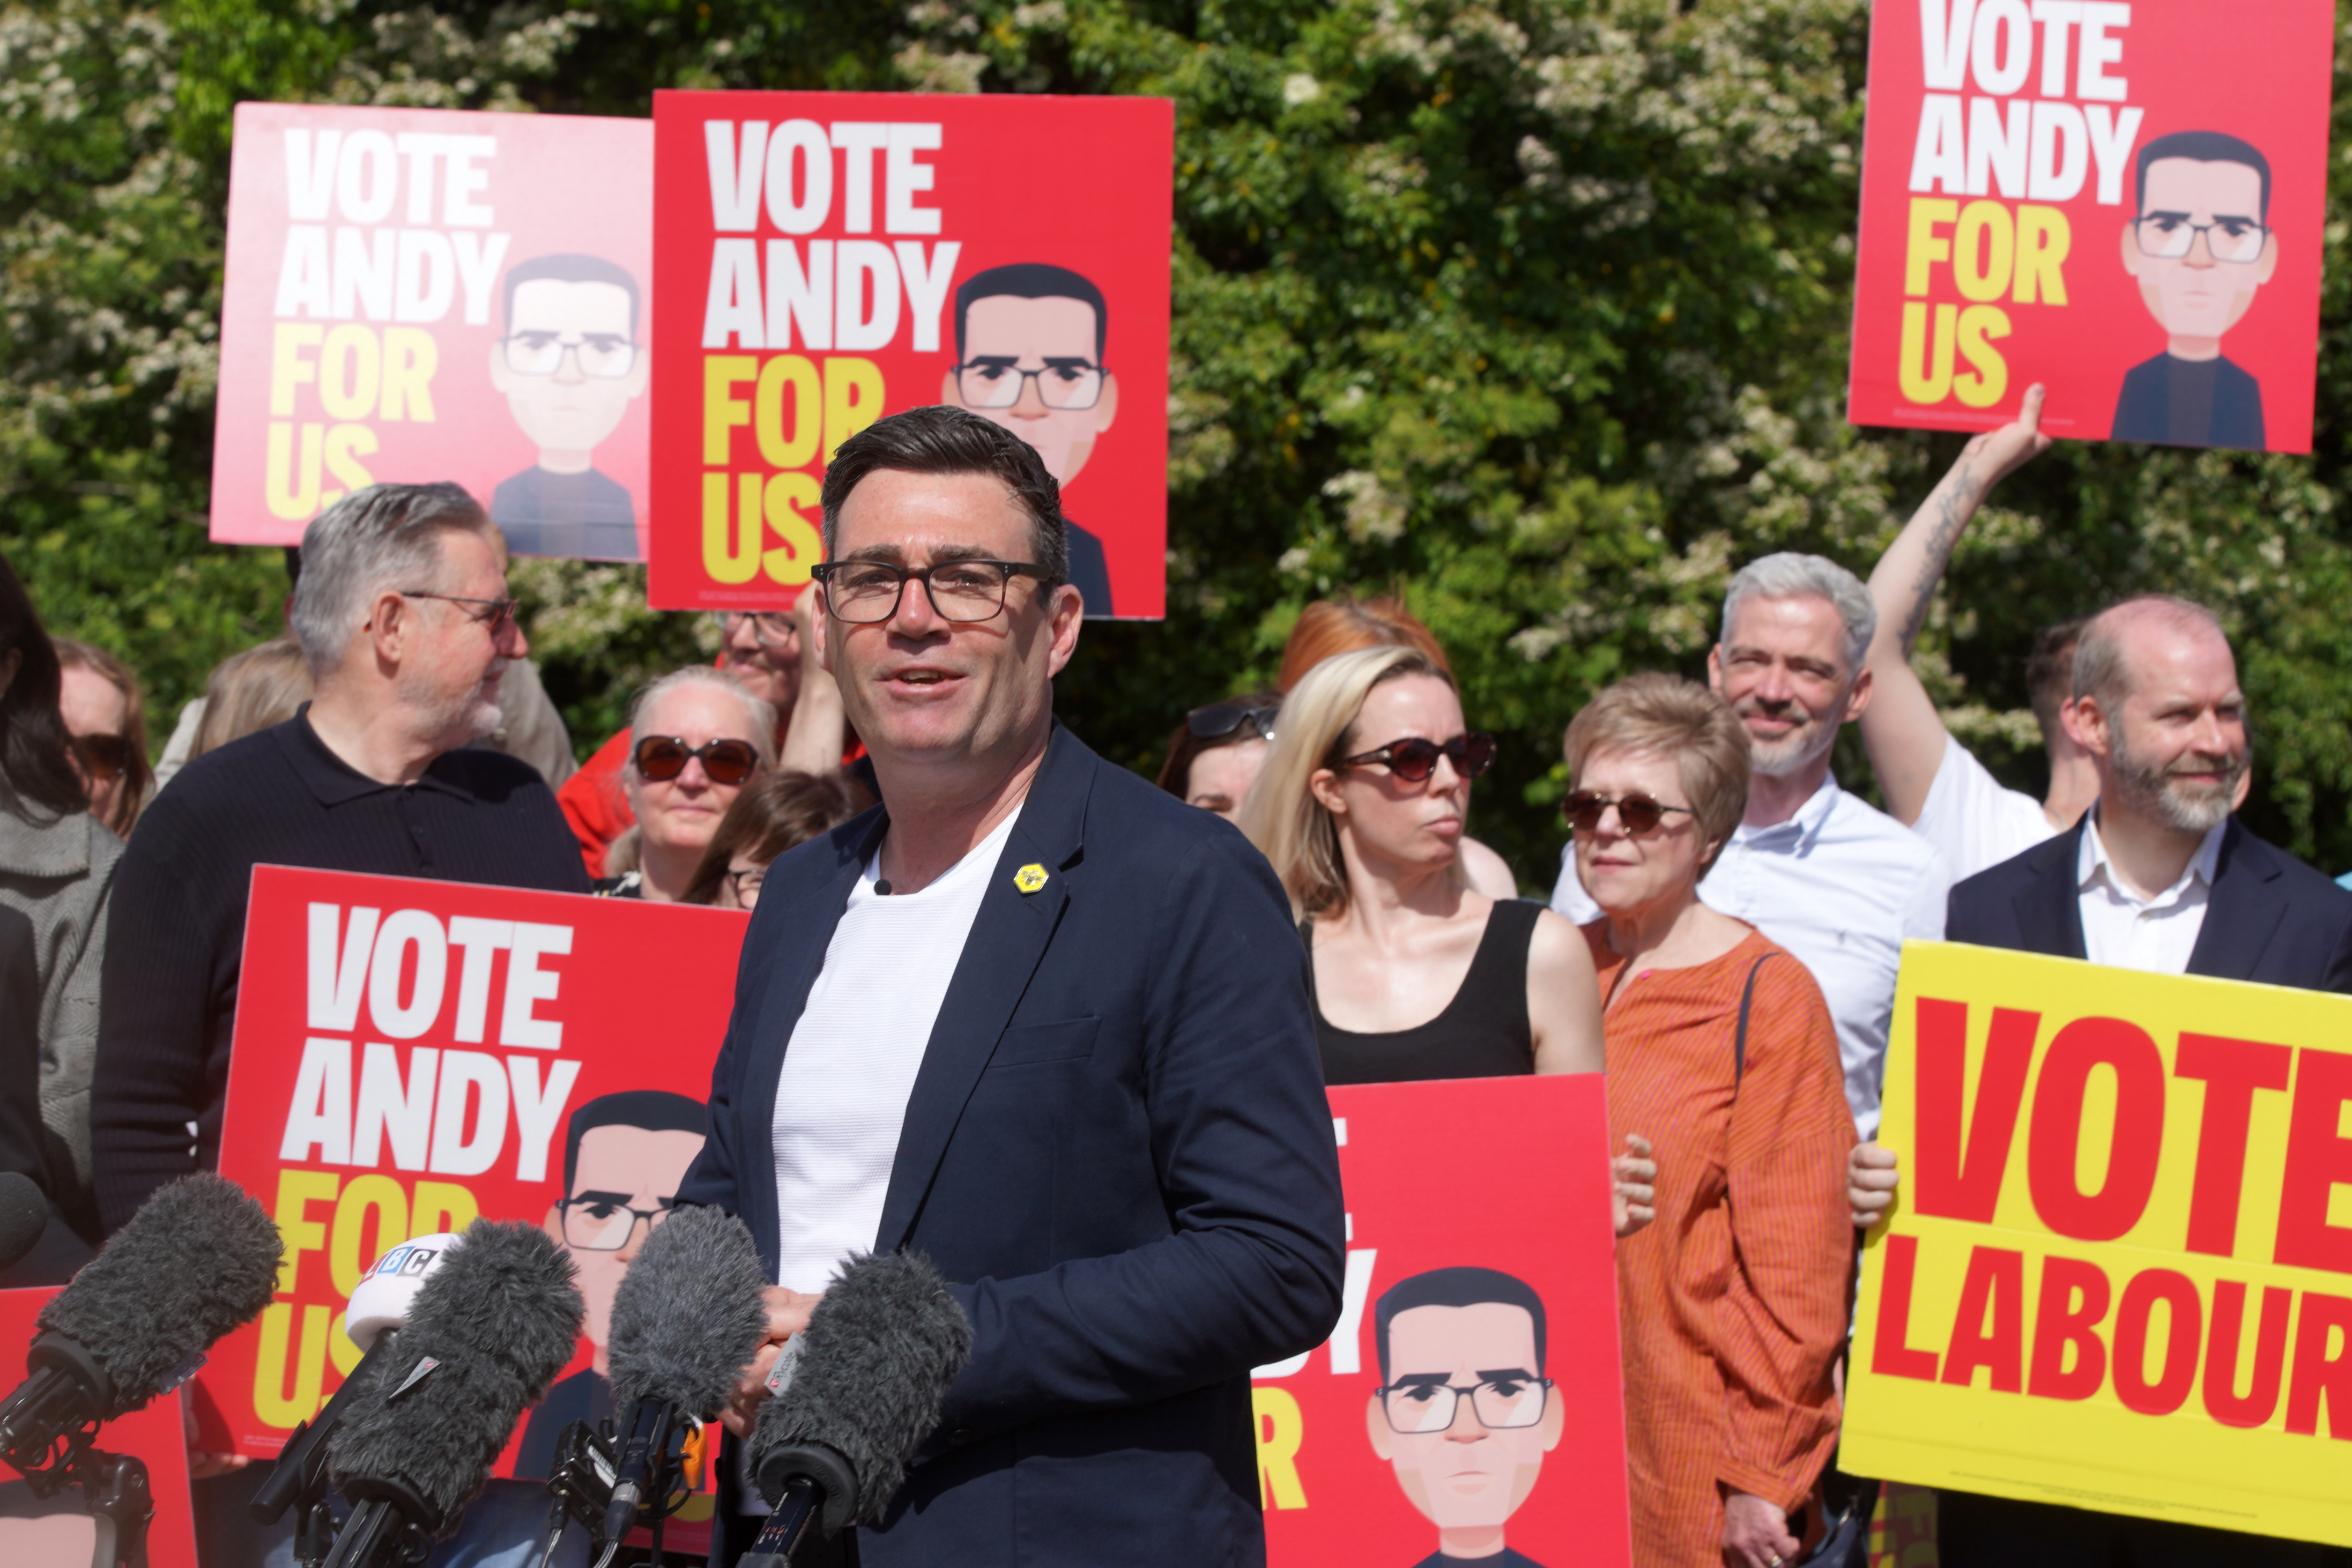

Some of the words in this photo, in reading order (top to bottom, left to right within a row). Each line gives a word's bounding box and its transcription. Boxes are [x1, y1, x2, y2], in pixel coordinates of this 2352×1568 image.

[1919, 0, 2131, 102] VOTE
[284, 129, 498, 227] VOTE
[704, 118, 943, 234] VOTE
[1908, 93, 2145, 205] ANDY
[273, 225, 512, 325] ANDY
[701, 237, 962, 352] ANDY
[1904, 196, 2072, 306] FOR
[269, 322, 439, 423] FOR
[1898, 301, 2012, 407] US
[265, 421, 380, 521] US
[702, 472, 823, 585] US
[307, 901, 574, 1051] VOTE
[278, 1036, 582, 1182] ANDY
[1915, 996, 2352, 1275] VOTE
[362, 1248, 431, 1280] LBC
[1871, 1233, 2352, 1443] LABOUR
